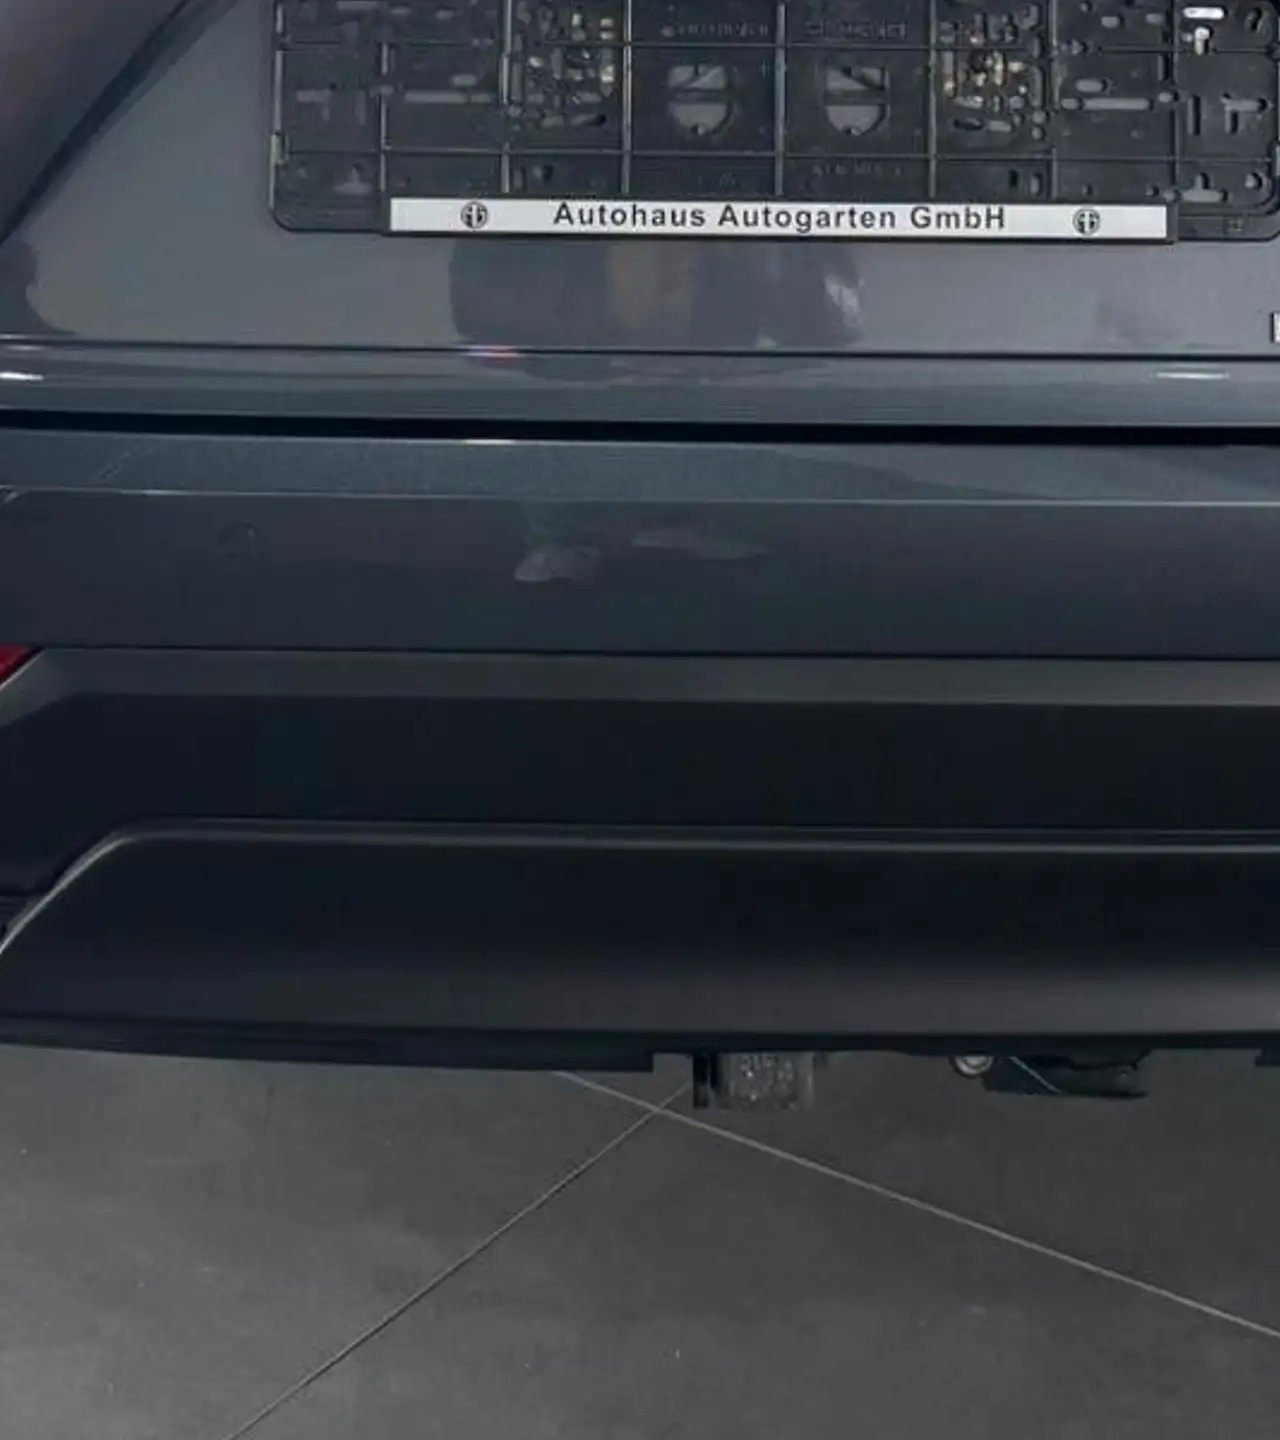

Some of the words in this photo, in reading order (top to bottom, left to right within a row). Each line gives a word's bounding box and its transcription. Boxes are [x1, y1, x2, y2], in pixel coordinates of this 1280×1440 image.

[553, 201, 706, 228] Autohaus
[719, 204, 896, 234] Autogarten
[910, 206, 1006, 230] GmbH
